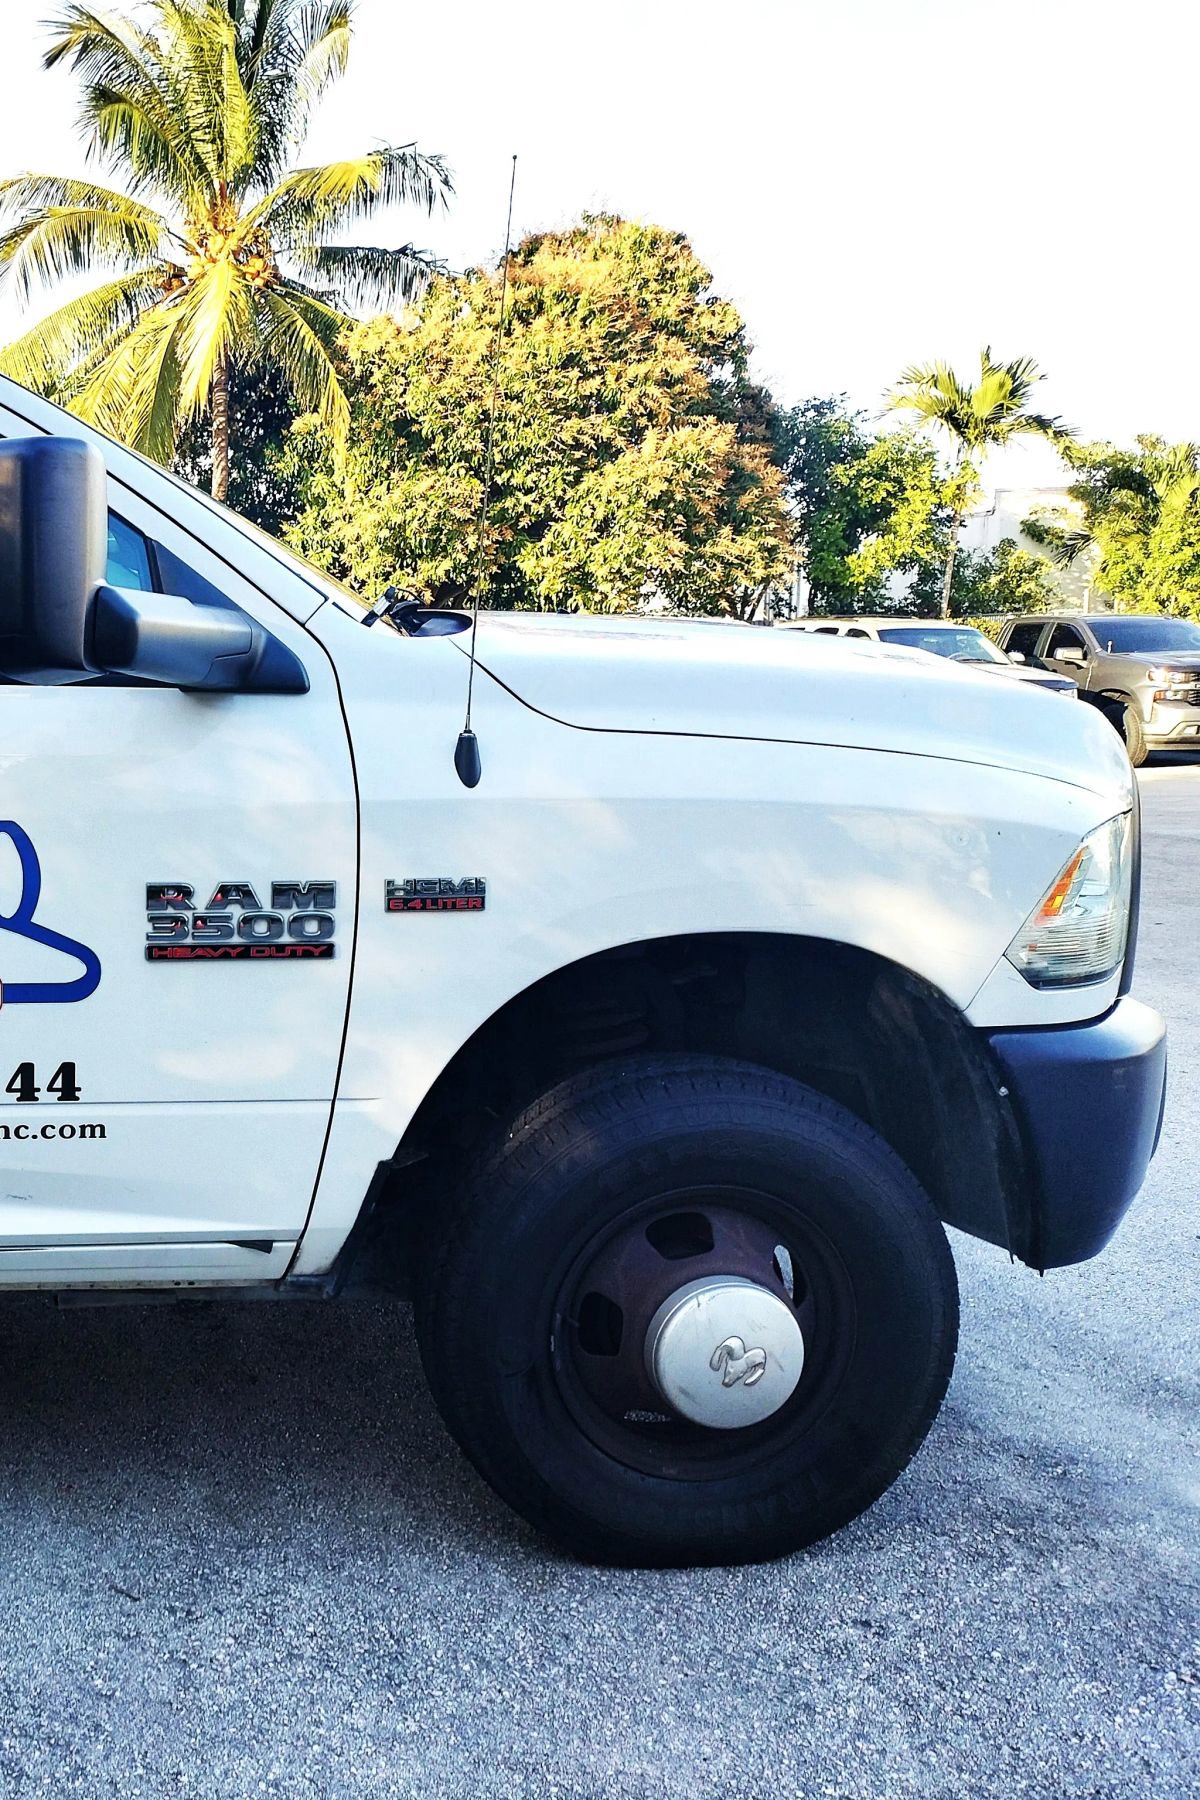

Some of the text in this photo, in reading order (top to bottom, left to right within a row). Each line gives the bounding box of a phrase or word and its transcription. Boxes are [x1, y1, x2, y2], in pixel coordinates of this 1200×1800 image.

[145, 881, 337, 910] RAM
[384, 877, 487, 897] HEMI
[389, 898, 483, 910] 6.4 LITER
[146, 912, 336, 941] 3500
[152, 944, 330, 959] HEAVY DUTY
